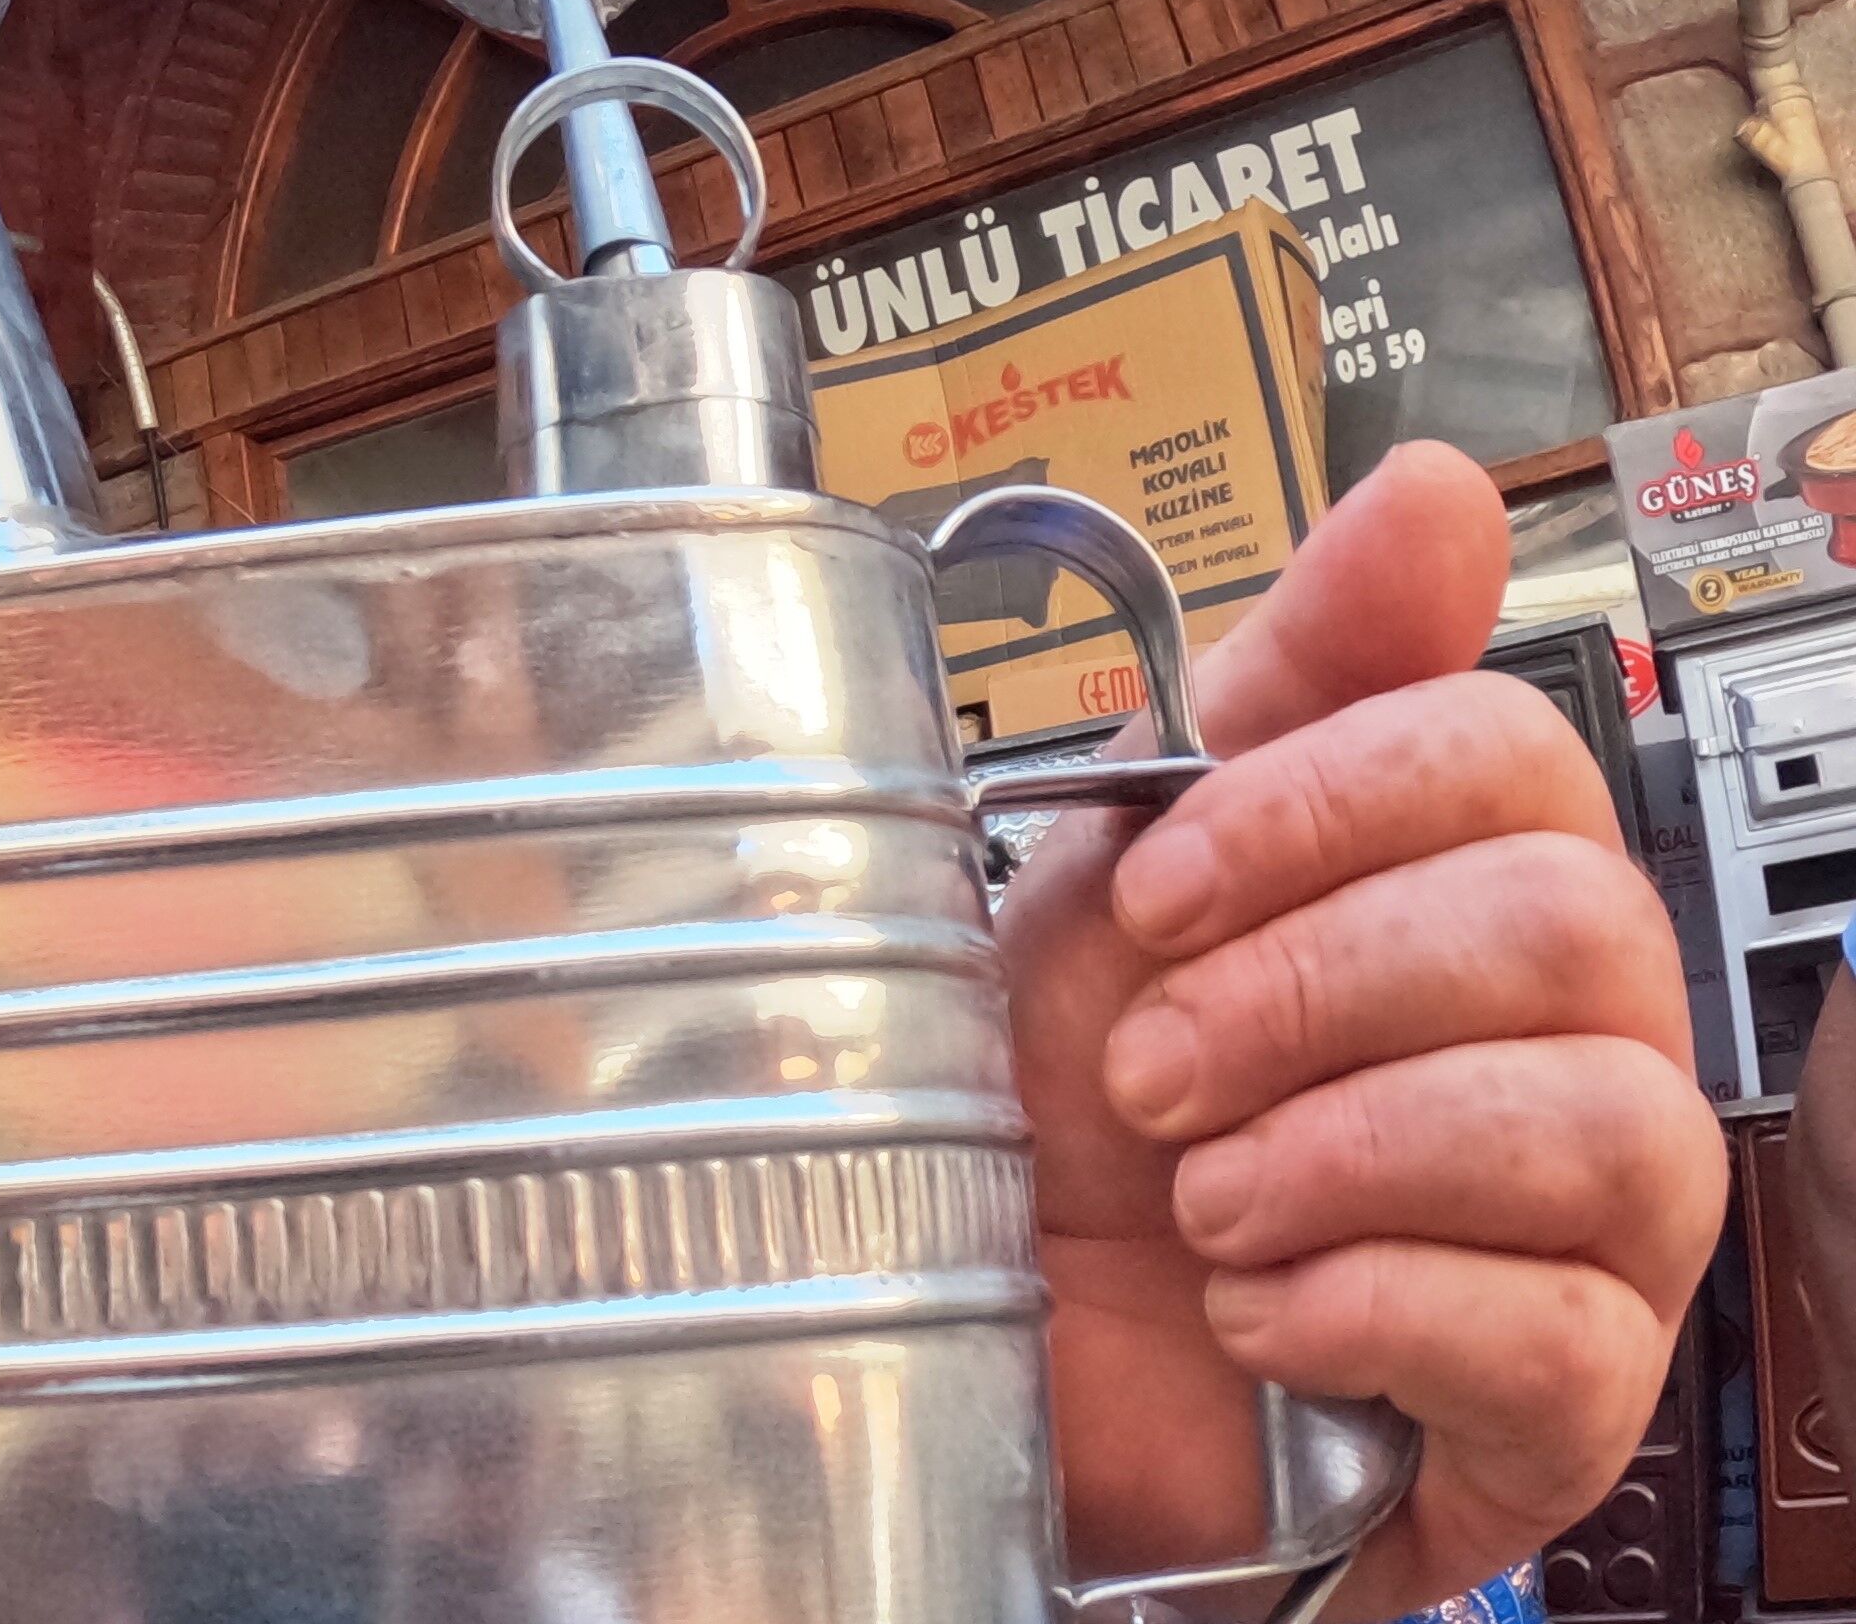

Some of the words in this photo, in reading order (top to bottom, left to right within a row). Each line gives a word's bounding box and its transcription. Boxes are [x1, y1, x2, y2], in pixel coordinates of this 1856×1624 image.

[810, 205, 1021, 357] ÜNLÜ
[1040, 107, 1367, 279] TİCARET
[1334, 348, 1378, 384] 05
[1387, 328, 1427, 371] 59
[951, 354, 1134, 456] KESTEK
[1129, 418, 1232, 470] MAJOLİK
[1142, 452, 1227, 496] KOVALI
[1642, 463, 1756, 511] GÜNEŞ
[1144, 481, 1234, 527] KUZİNE
[1704, 583, 1718, 599] 2
[1734, 566, 1765, 579] YEAR
